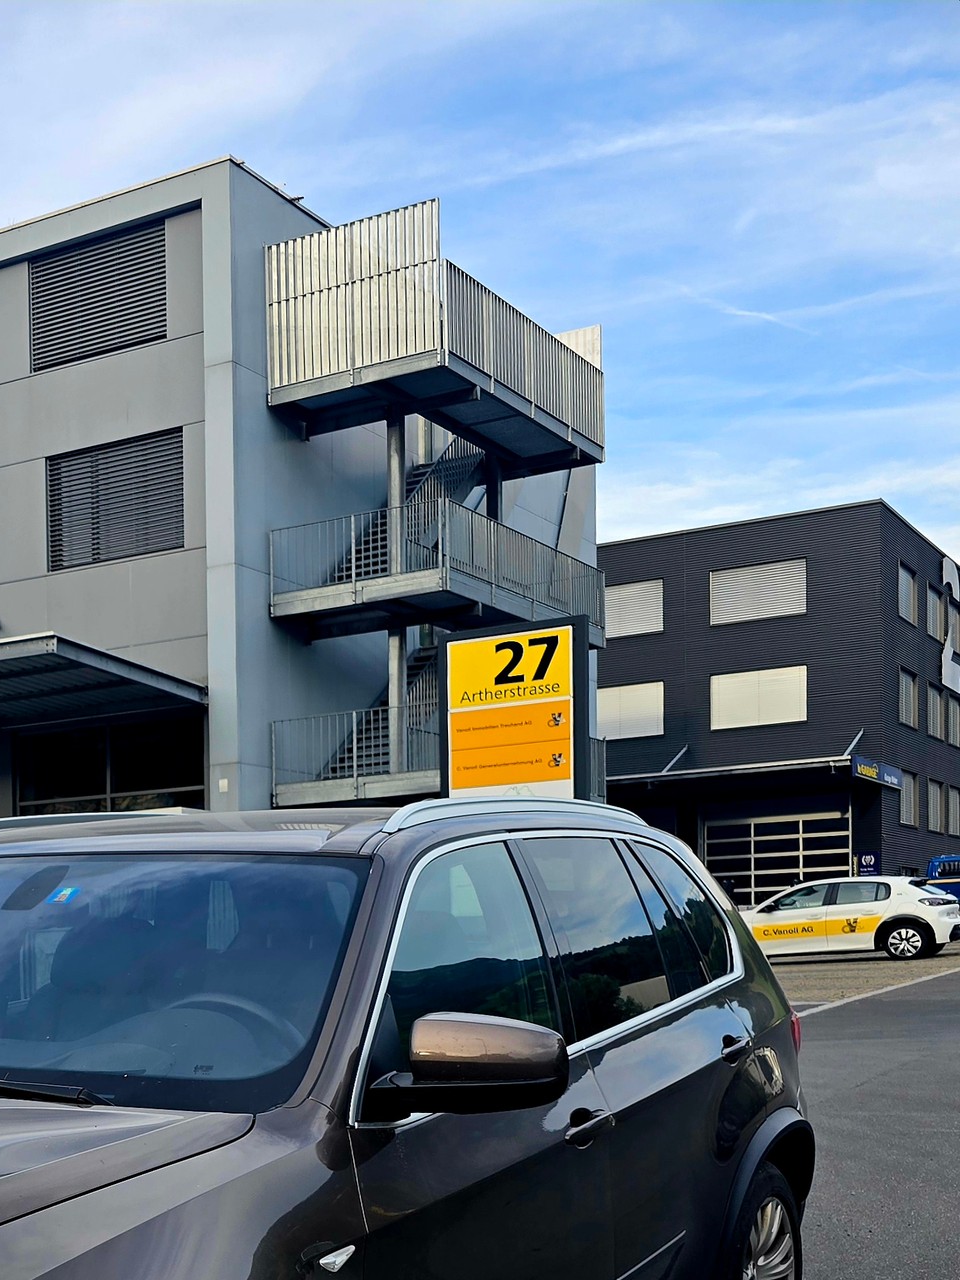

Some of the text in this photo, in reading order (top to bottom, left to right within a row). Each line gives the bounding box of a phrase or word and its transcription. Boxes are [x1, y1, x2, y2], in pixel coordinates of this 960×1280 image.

[495, 635, 559, 685] 27
[460, 683, 560, 704] Artherstrasse
[773, 927, 799, 936] Vanoli
